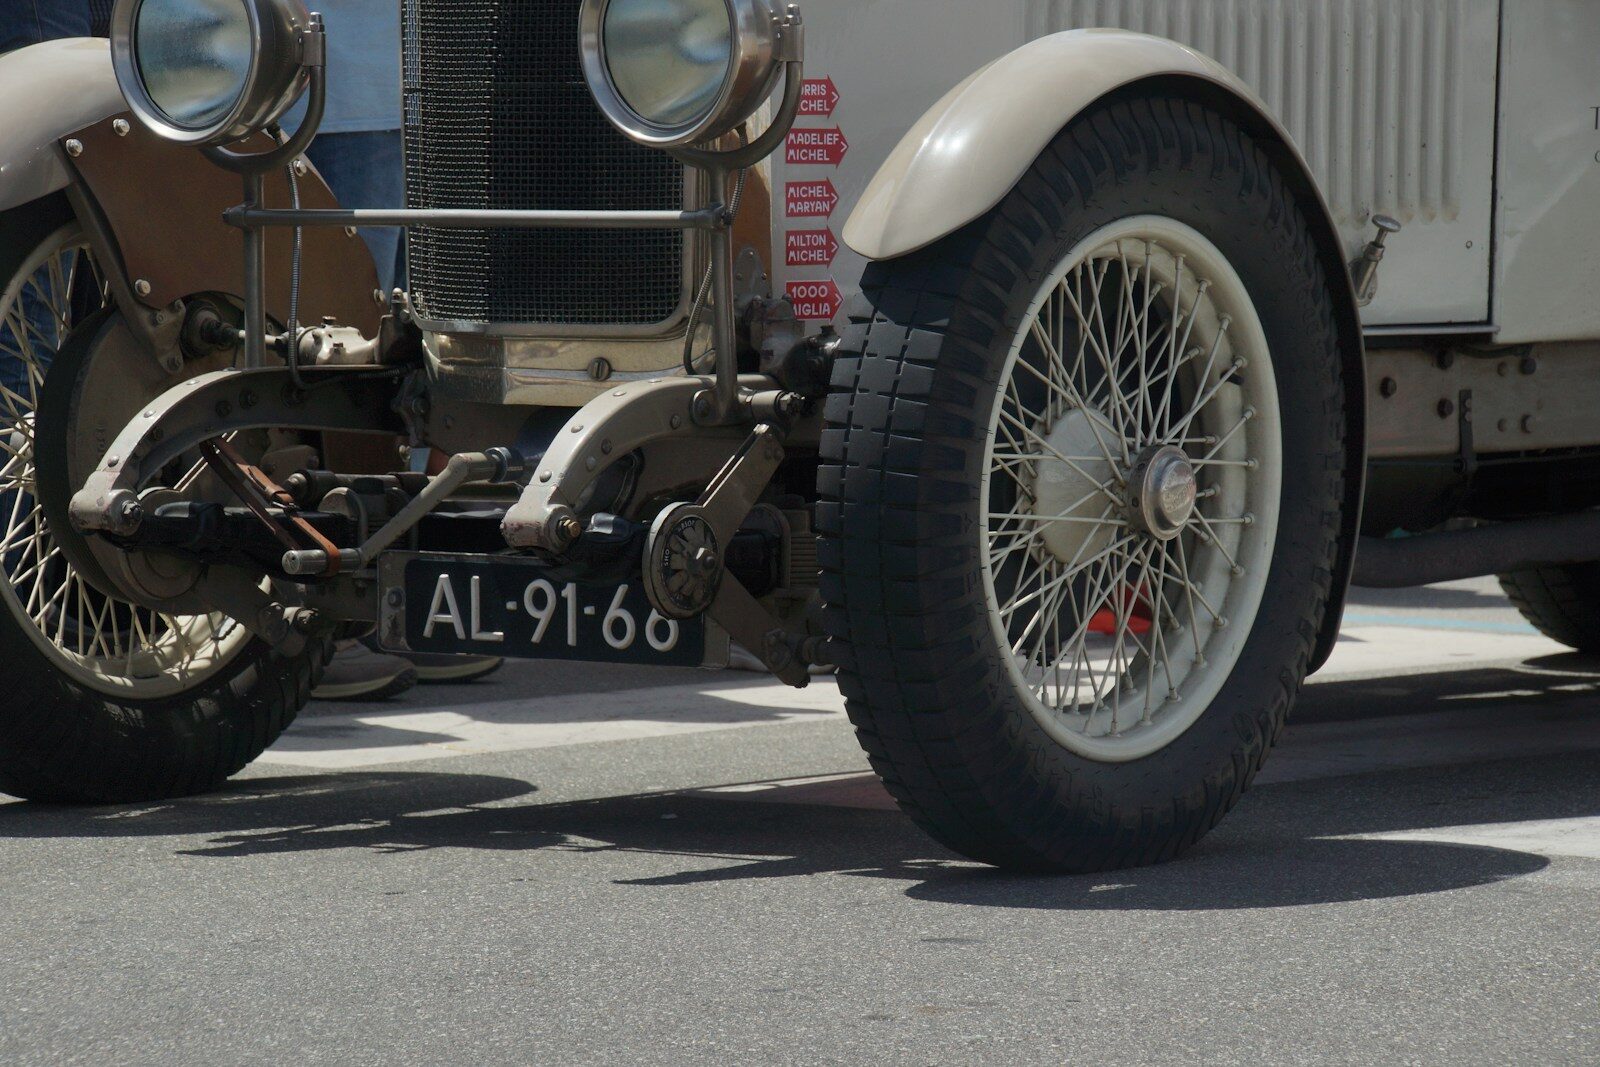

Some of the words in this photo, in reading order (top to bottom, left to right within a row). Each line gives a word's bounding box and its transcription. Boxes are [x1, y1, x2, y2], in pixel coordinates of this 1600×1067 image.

[787, 133, 839, 145] MADELIEF
[787, 149, 830, 161] MICHEL
[787, 185, 830, 198] MICHEL
[788, 200, 830, 213] MARYAN
[788, 234, 827, 247] MILTON
[788, 250, 830, 262] MICHEL
[791, 285, 828, 298] 1000
[423, 573, 680, 652] AL-91-66
